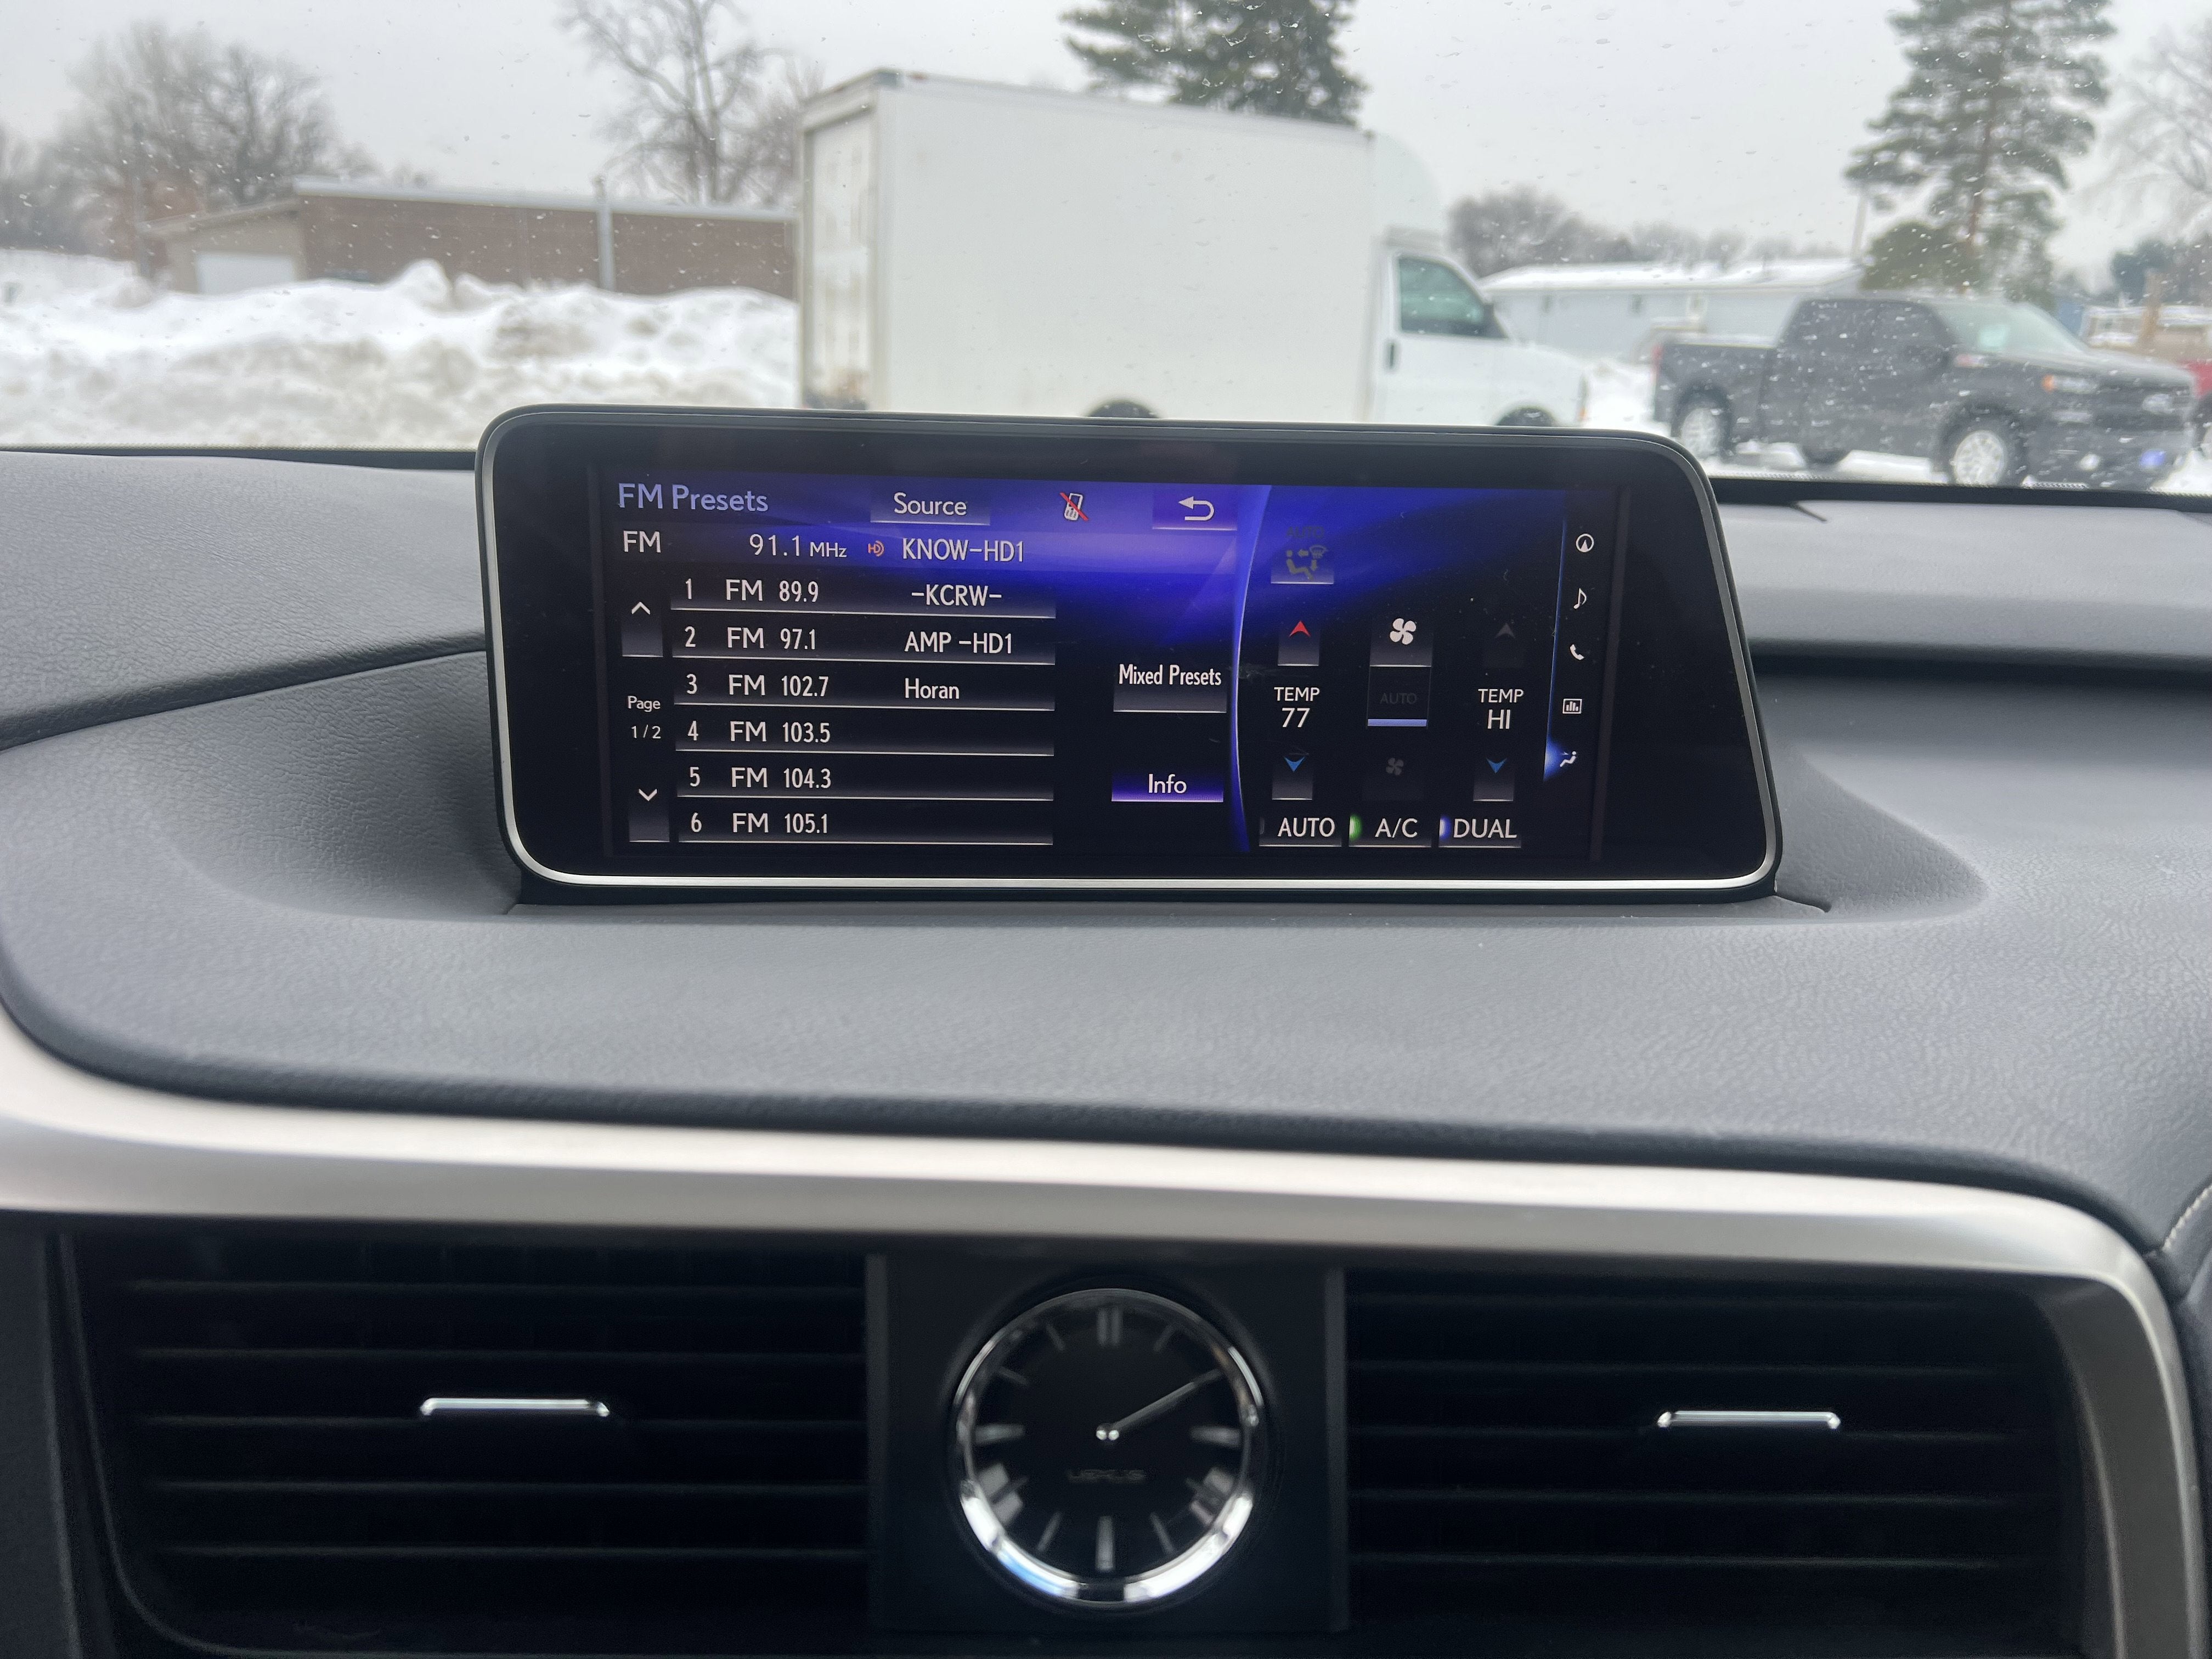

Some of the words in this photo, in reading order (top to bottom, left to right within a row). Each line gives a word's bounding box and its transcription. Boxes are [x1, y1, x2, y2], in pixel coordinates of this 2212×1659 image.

[618, 483, 663, 508] FM
[673, 485, 768, 512] Presets
[894, 492, 967, 515] Source
[623, 530, 661, 552] FM
[749, 534, 801, 557] 91.1
[810, 542, 847, 557] MHz
[902, 538, 1024, 562] KNOW-HD1
[686, 578, 693, 599] 1
[726, 579, 763, 601] FM
[779, 581, 819, 602] 89.9
[912, 584, 1001, 606] -KCRW-
[685, 627, 696, 647] 2
[728, 627, 764, 648] FM
[780, 629, 816, 650] 97.1
[905, 631, 951, 652] AMP
[686, 674, 697, 694] 3
[729, 674, 765, 695] FM
[782, 676, 828, 697] 102.7
[1119, 664, 1163, 684] Mixed
[1169, 665, 1222, 686] Presets
[905, 678, 960, 699] Horan
[1274, 686, 1319, 701] TEMP
[1380, 691, 1417, 704] AUTO
[1479, 689, 1523, 703] TEMP
[628, 695, 661, 712] Page
[1282, 708, 1310, 728] 77
[1488, 709, 1510, 729] HI
[687, 720, 698, 741] 4
[730, 721, 767, 741] FM
[783, 722, 831, 743] 103.5
[689, 766, 700, 786] 5
[731, 766, 768, 787] FM
[784, 768, 831, 789] 104.3
[1148, 774, 1187, 795] Info
[691, 812, 702, 832] 6
[733, 812, 769, 833] FM
[785, 813, 827, 833] 105.1
[1278, 817, 1335, 838] AUTO
[1375, 817, 1418, 838] A/C
[1453, 819, 1517, 839] DUAL
